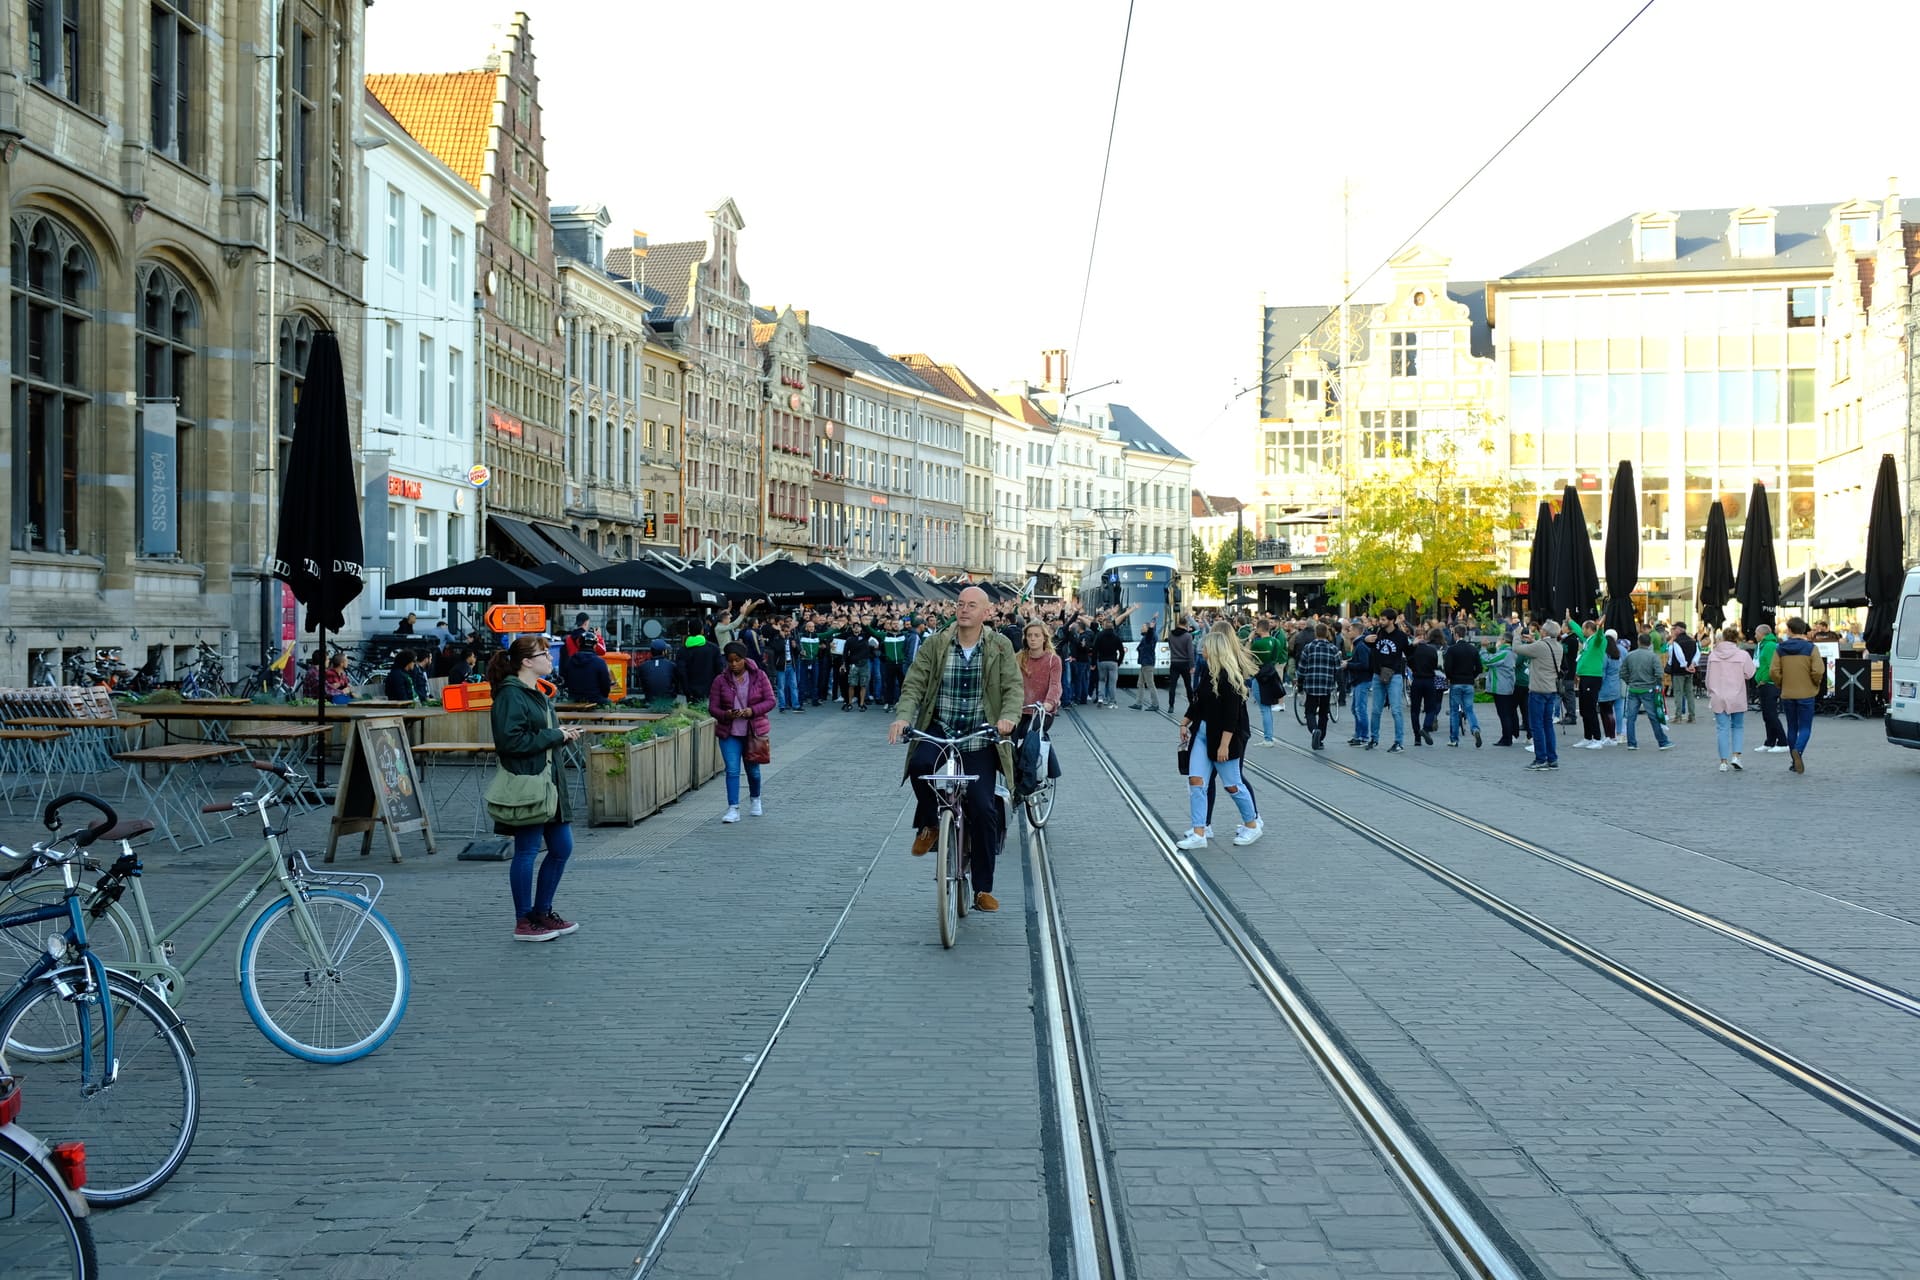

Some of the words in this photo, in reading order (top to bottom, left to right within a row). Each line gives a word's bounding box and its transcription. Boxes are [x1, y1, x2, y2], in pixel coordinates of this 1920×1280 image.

[1122, 571, 1128, 580] 4
[429, 587, 466, 596] BURGER
[467, 587, 492, 596] KING
[582, 588, 619, 597] BURGER
[621, 588, 646, 598] KING
[237, 888, 257, 909] UNION
